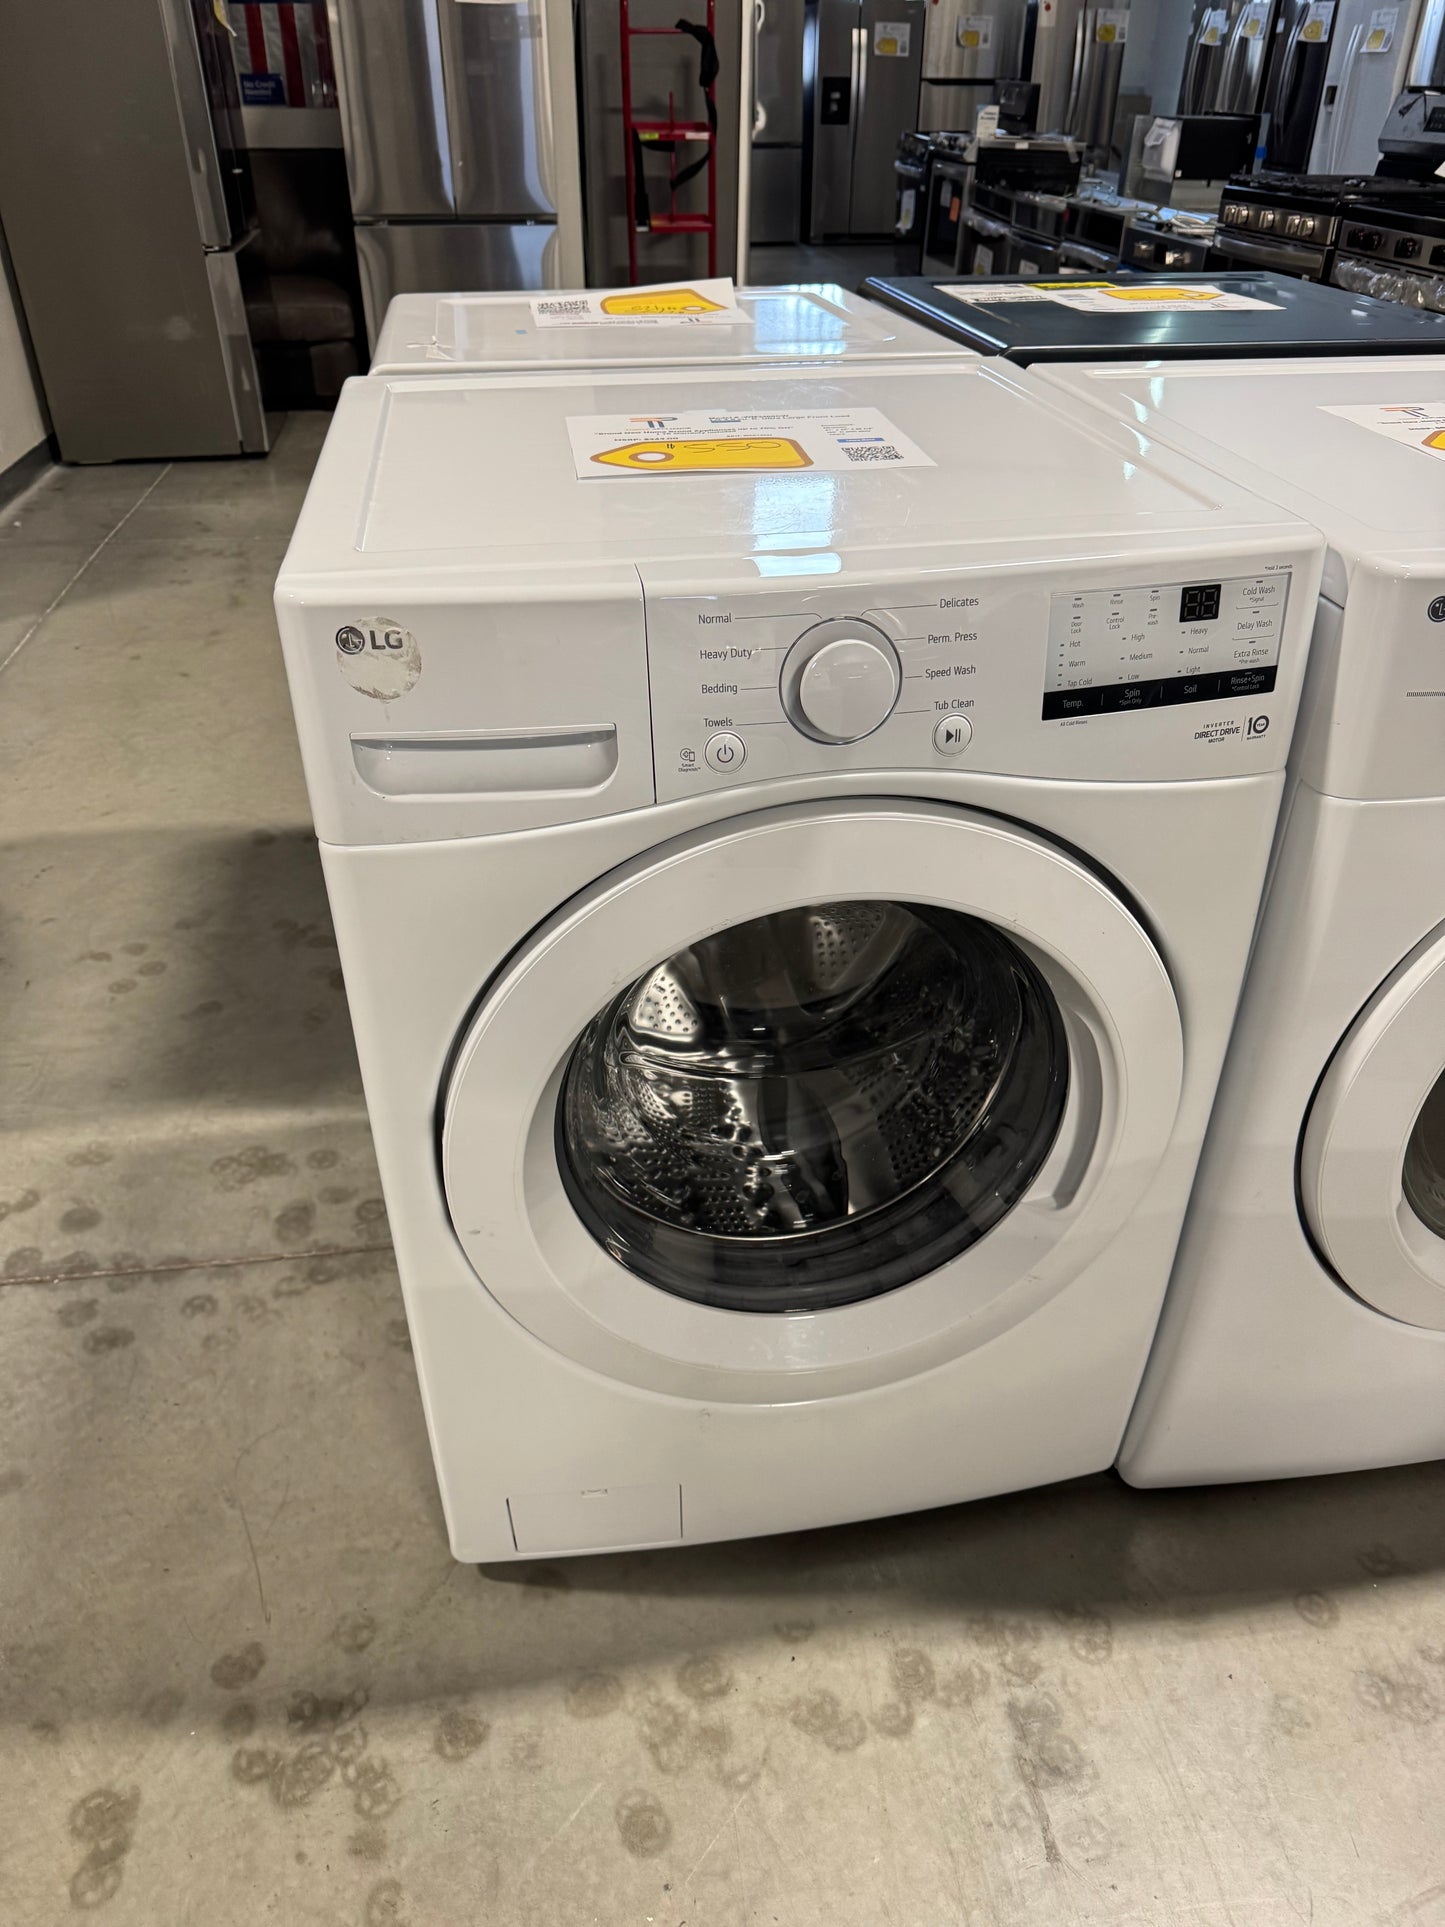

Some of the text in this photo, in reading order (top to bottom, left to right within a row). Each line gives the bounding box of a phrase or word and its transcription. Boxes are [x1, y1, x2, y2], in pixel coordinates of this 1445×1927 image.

[1242, 585, 1276, 596] Cold Wash
[940, 598, 979, 609] Delicates
[698, 612, 732, 625] Normal
[1106, 616, 1125, 624] Control
[1237, 620, 1273, 631] Delay Wash
[1130, 633, 1145, 642] High
[1190, 628, 1209, 636] Heavy
[369, 629, 404, 650] LG
[927, 632, 978, 644] Perm. Press
[699, 648, 753, 661] Heavy Duty
[1188, 646, 1209, 654] Normal
[1233, 648, 1269, 658] Extra Rinse
[1129, 652, 1153, 661] Medium
[925, 664, 976, 680] Speed Wash
[1186, 666, 1201, 674] Light
[1067, 678, 1093, 688] Tap Cold
[701, 683, 738, 695] Bedding
[1124, 688, 1141, 699] Spin
[1184, 684, 1198, 694] Soil
[934, 698, 975, 710] Tub Clean
[1062, 699, 1084, 708] Temp.
[703, 716, 733, 727] Towels
[1246, 715, 1270, 736] 10
[1194, 726, 1241, 740] DIRECT DRIVE
